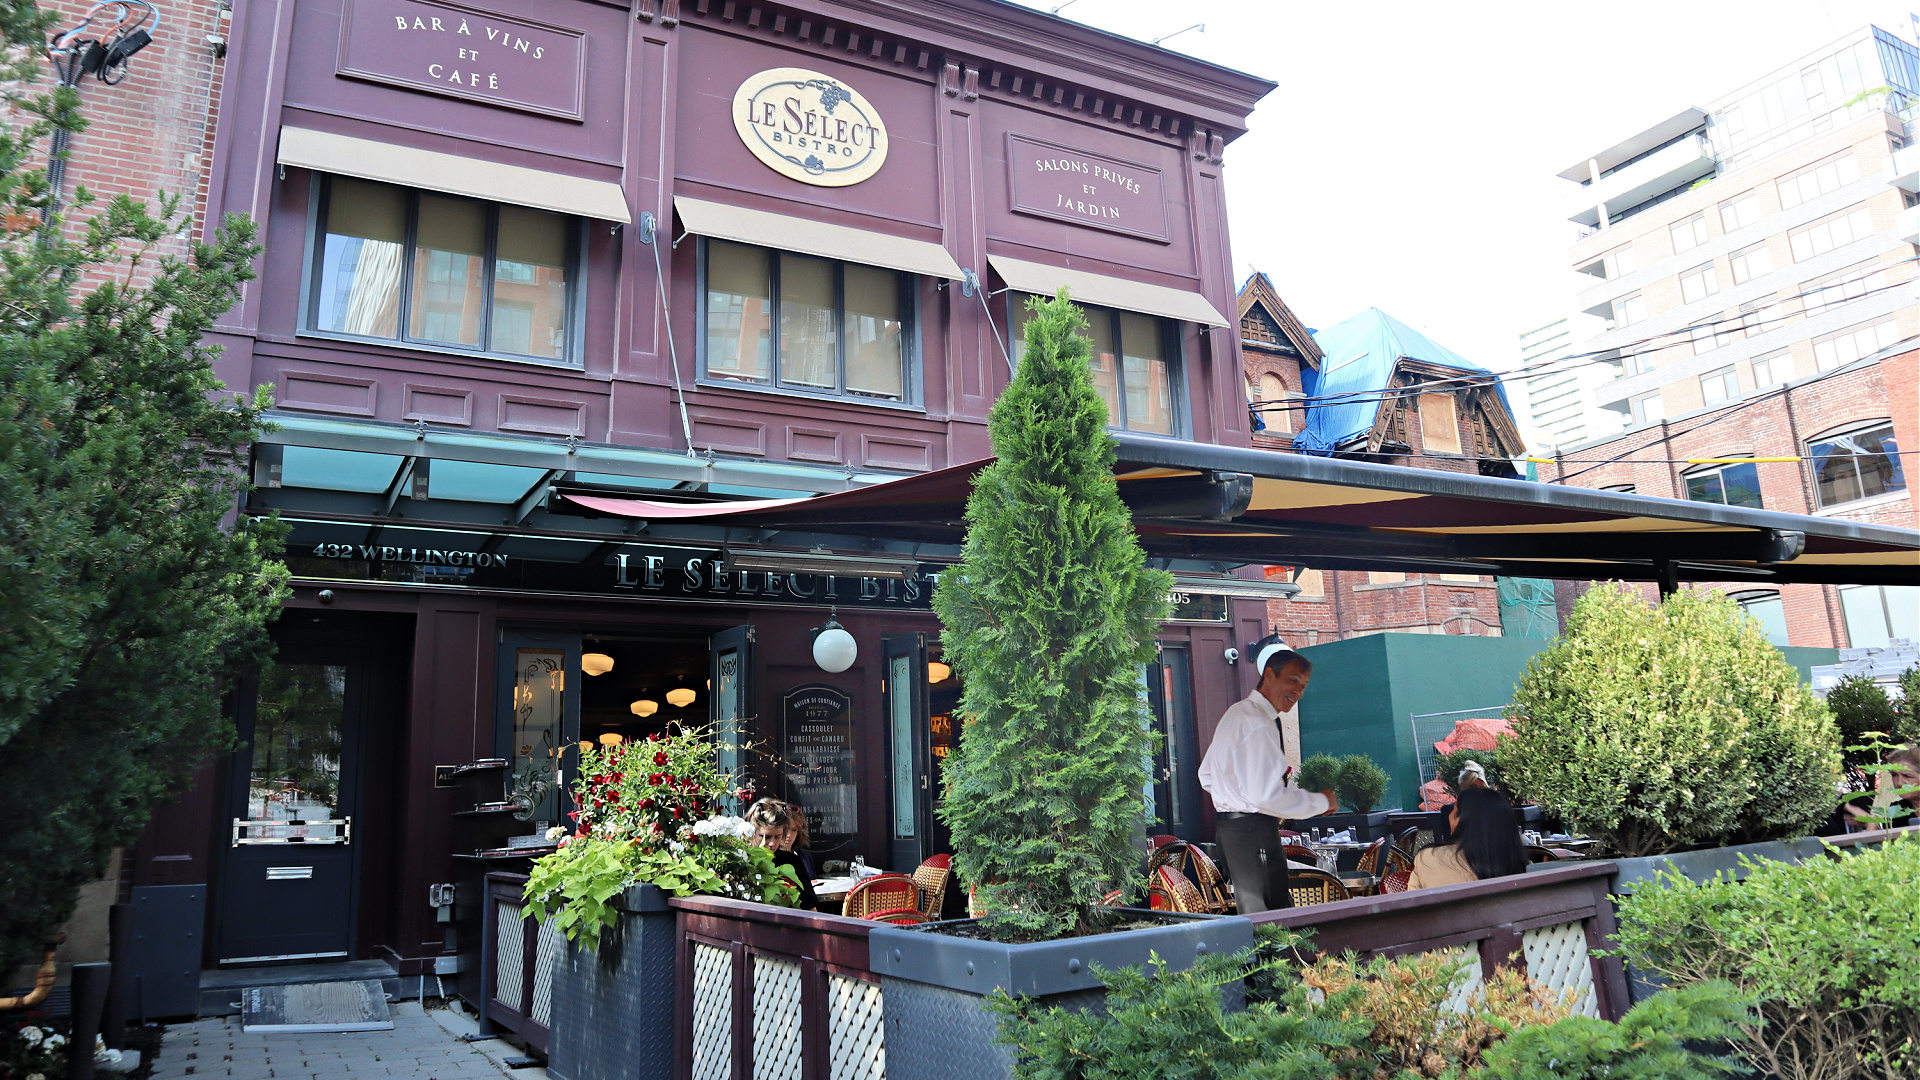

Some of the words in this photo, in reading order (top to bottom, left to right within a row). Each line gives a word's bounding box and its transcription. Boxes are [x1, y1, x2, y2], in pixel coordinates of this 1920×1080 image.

[395, 16, 445, 33] BAR
[456, 19, 471, 35] À
[485, 26, 545, 60] VINS
[459, 48, 479, 62] ET
[428, 63, 499, 90] CAFÉ
[747, 98, 776, 127] LE
[783, 96, 880, 150] SÉLECT
[773, 131, 853, 157] BISTRO
[1035, 159, 1089, 174] SALONS
[1094, 165, 1141, 194] PRIVÉS
[1083, 184, 1097, 195] ET
[1057, 194, 1120, 218] JARDIN
[312, 542, 353, 559] 432
[358, 544, 509, 568] WELLINGTON
[614, 553, 665, 590] LE
[789, 735, 811, 743] CONFIT
[821, 735, 845, 743] CANARD
[800, 725, 834, 733] CASSOULET
[794, 745, 841, 753] BOUILLABAISSE
